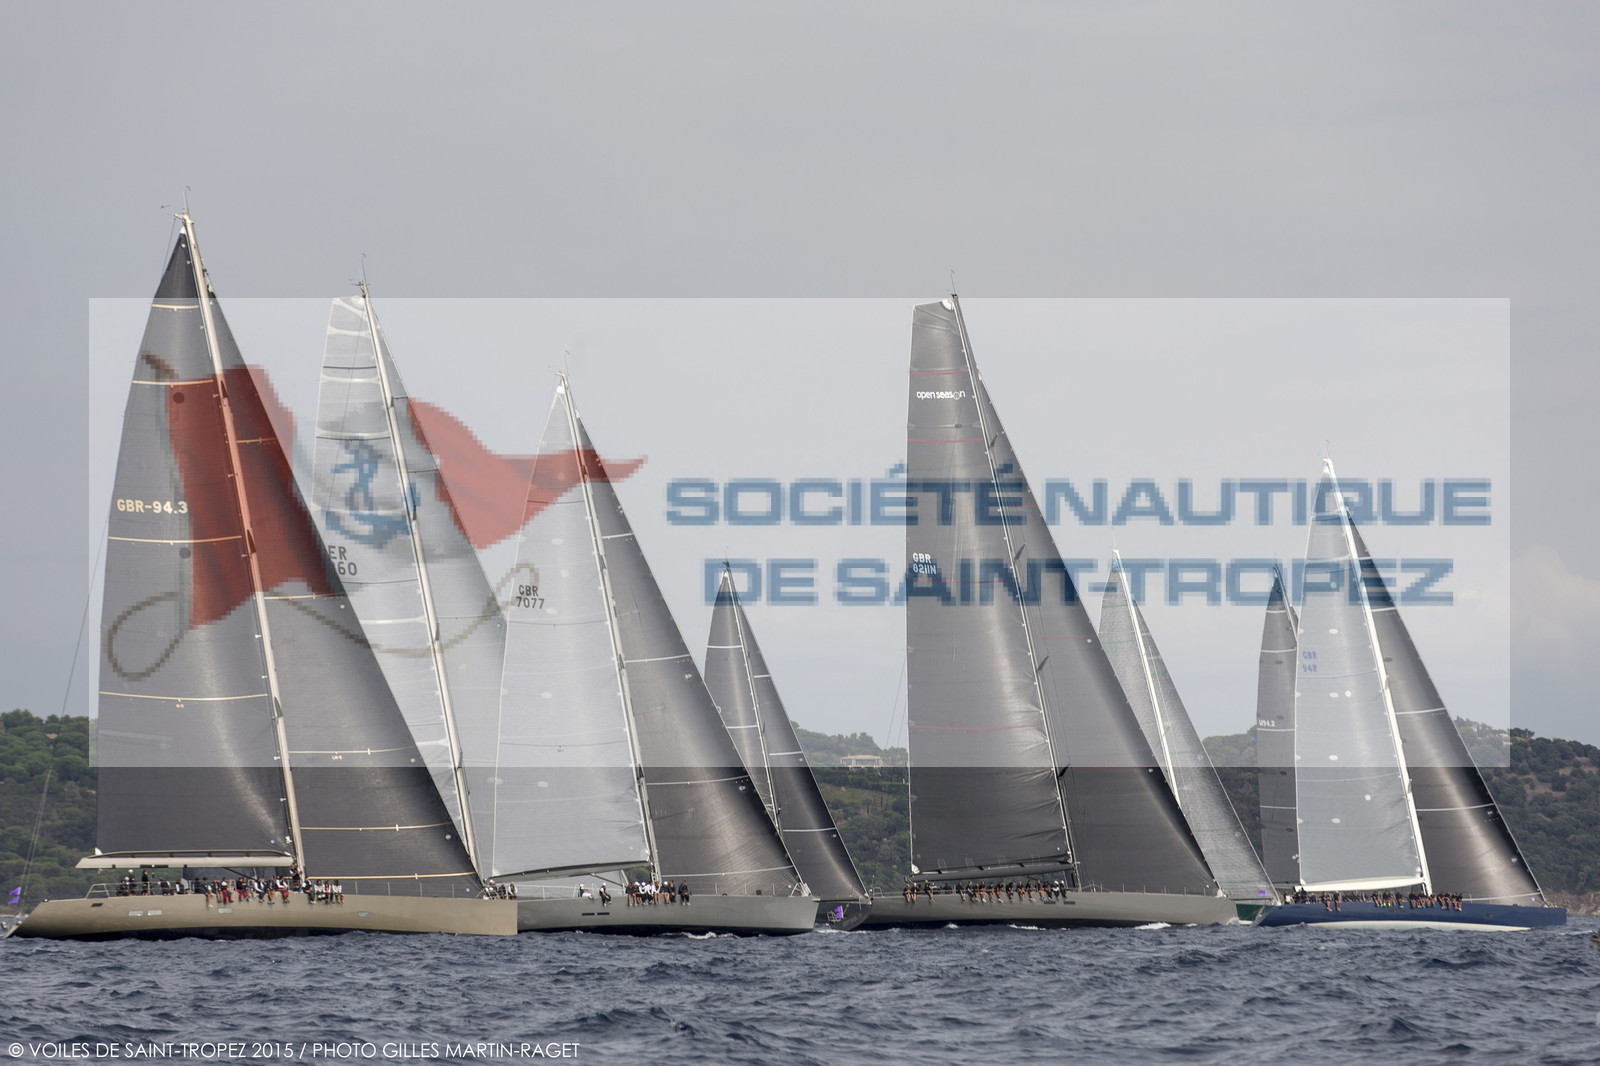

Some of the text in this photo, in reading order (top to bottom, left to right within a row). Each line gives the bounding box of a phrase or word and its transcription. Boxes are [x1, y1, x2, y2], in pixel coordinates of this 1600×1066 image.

[116, 498, 188, 514] GBR-94.3
[912, 552, 932, 563] GBR
[516, 596, 545, 609] 7077
